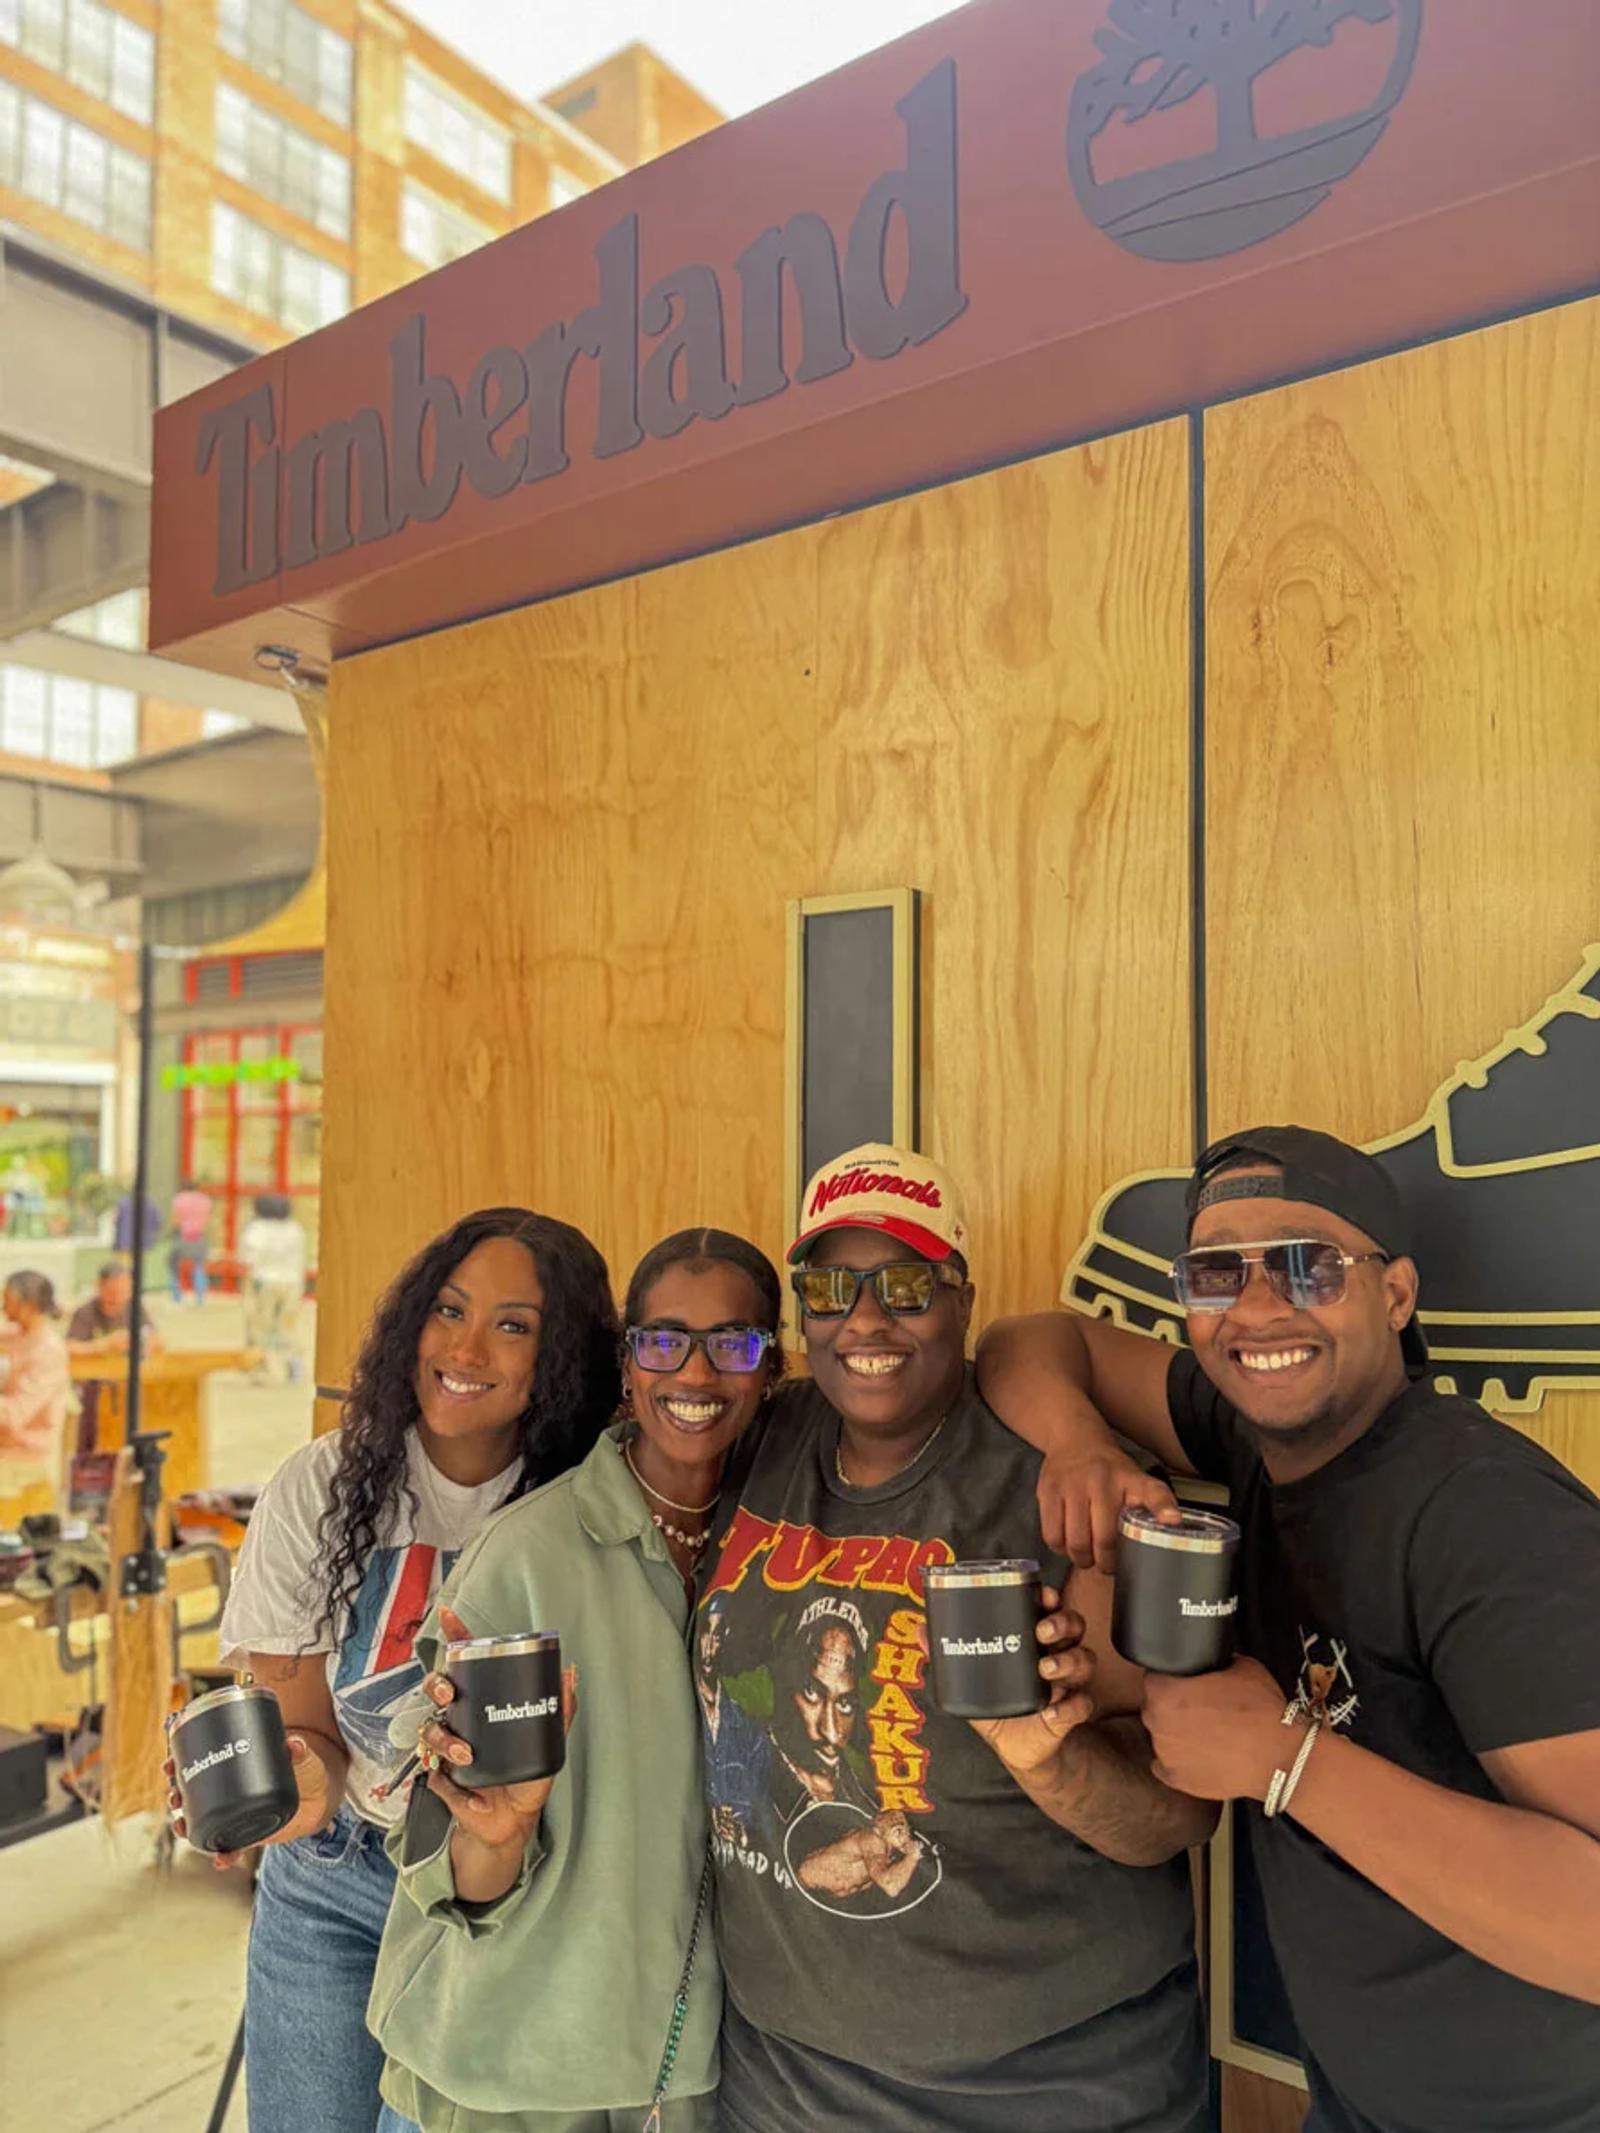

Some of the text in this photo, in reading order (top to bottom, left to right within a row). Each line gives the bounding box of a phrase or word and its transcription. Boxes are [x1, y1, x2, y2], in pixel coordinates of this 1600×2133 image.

[195, 55, 970, 598] Timberland
[808, 1168, 942, 1218] Nationals
[940, 1635, 1004, 1656] Timberland
[484, 1698, 547, 1723] Timberland
[868, 1608, 936, 1815] SHAKUR
[182, 1742, 234, 1783] Timberland
